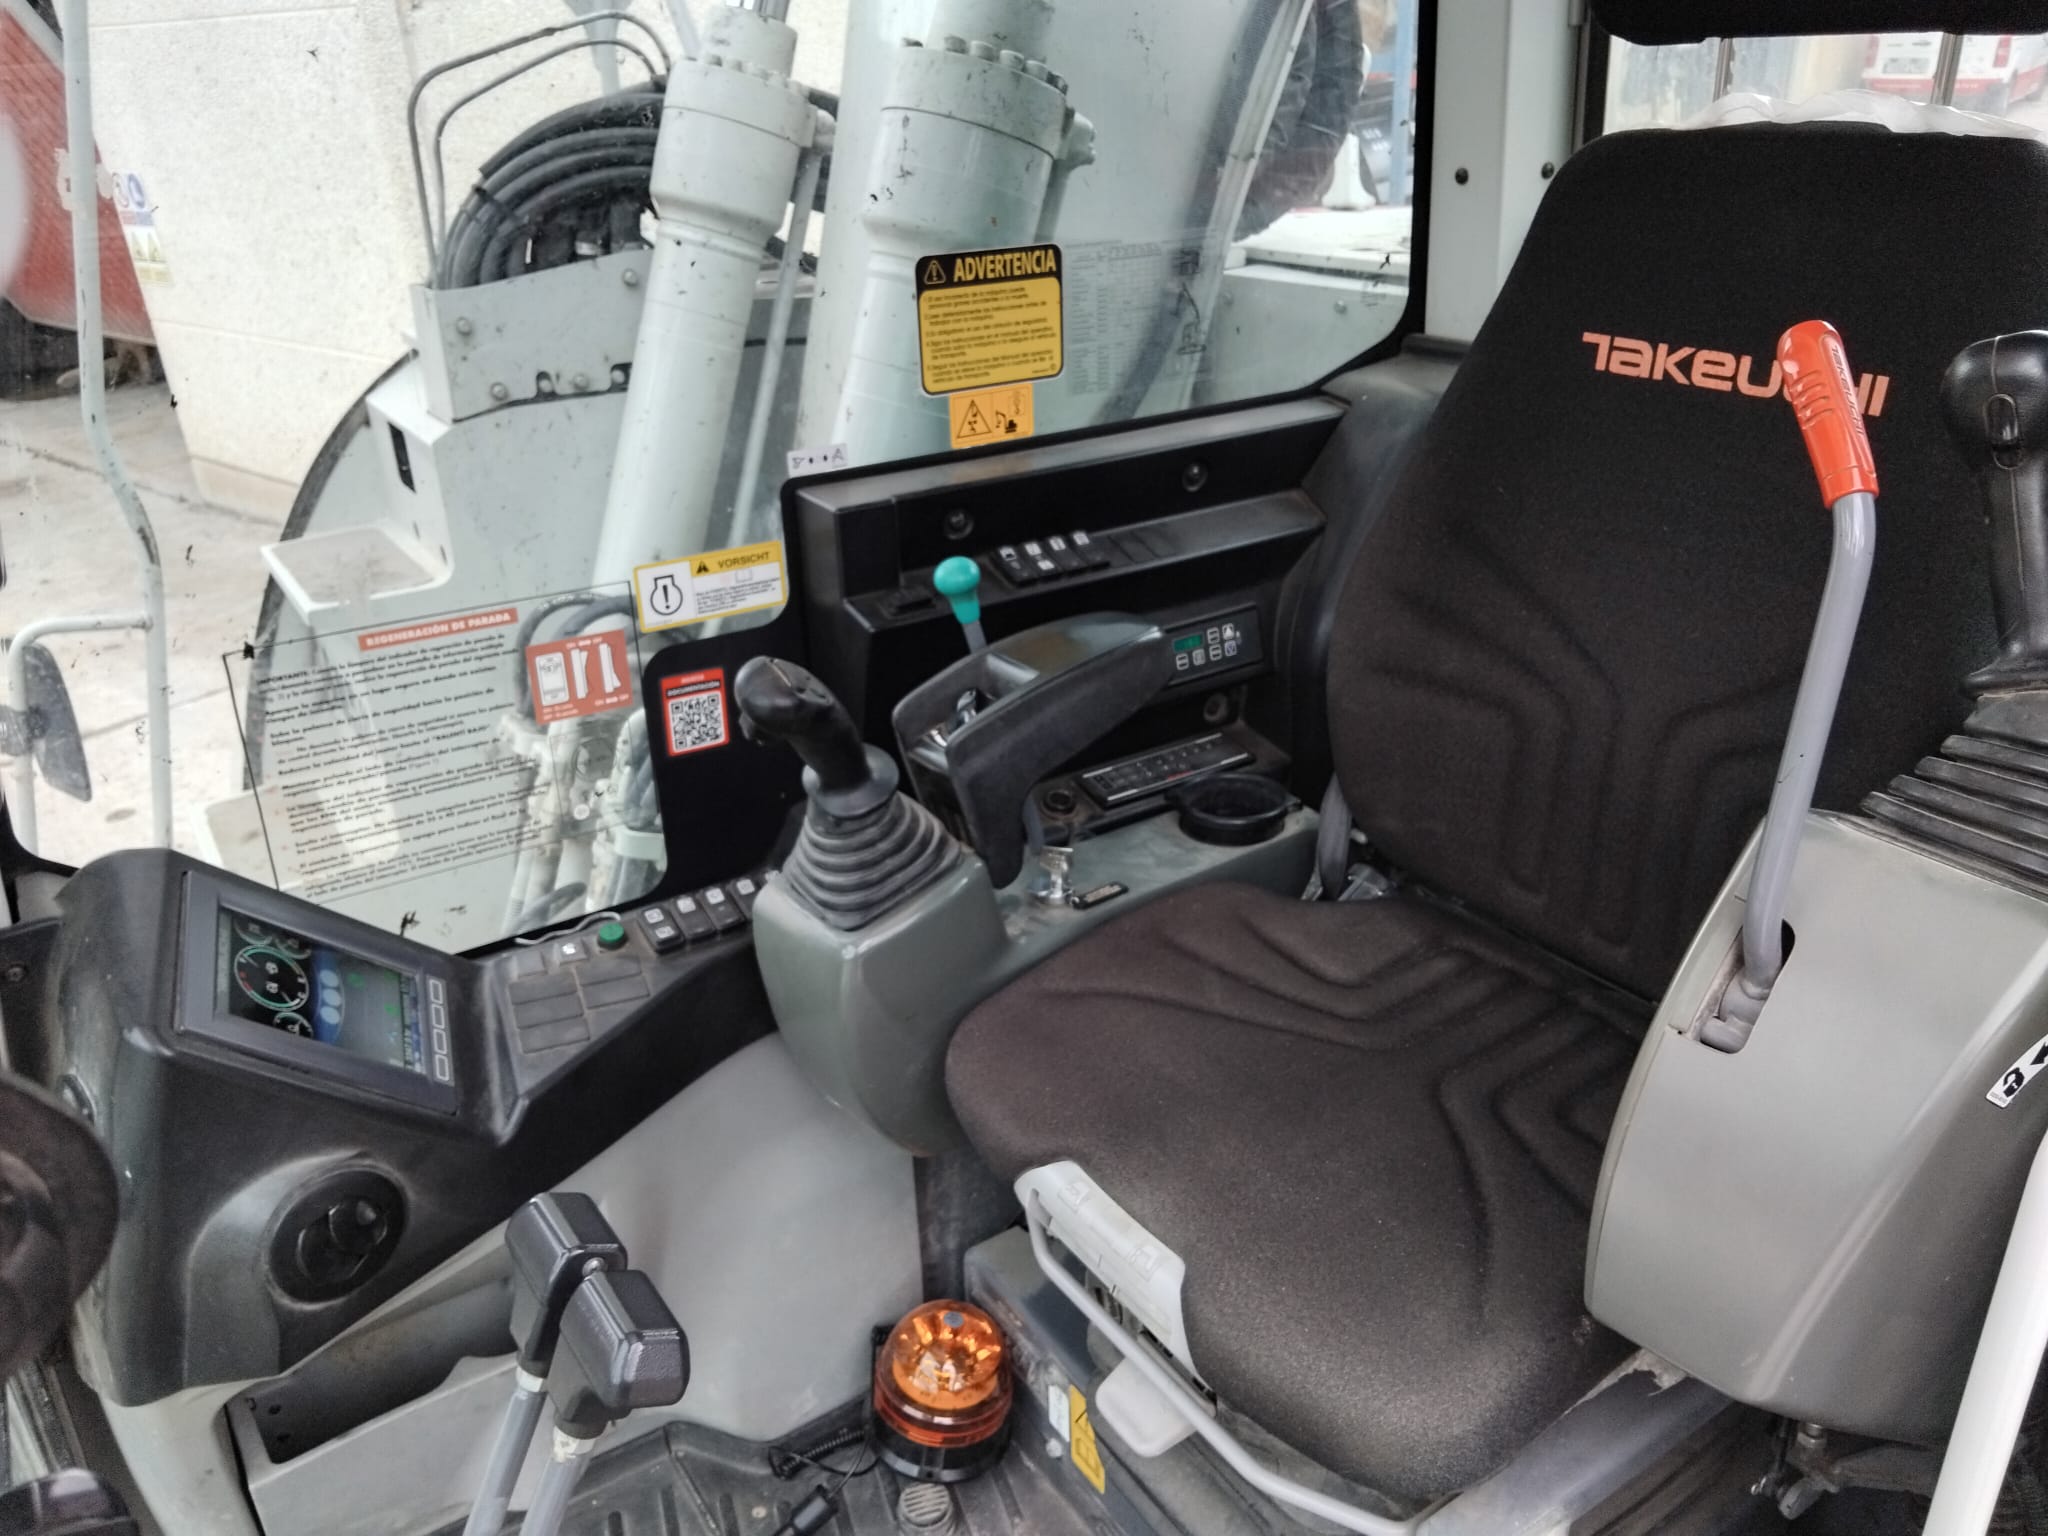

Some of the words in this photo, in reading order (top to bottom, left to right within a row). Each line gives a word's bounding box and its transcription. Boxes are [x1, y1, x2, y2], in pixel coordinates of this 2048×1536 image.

[953, 249, 1057, 282] ADVERTENCIA
[1581, 331, 1891, 417] TAKEUI
[717, 551, 770, 569] VORSICHT
[365, 622, 449, 647] REGENERACIÓN
[451, 620, 466, 632] DE
[468, 612, 512, 628] PARADA
